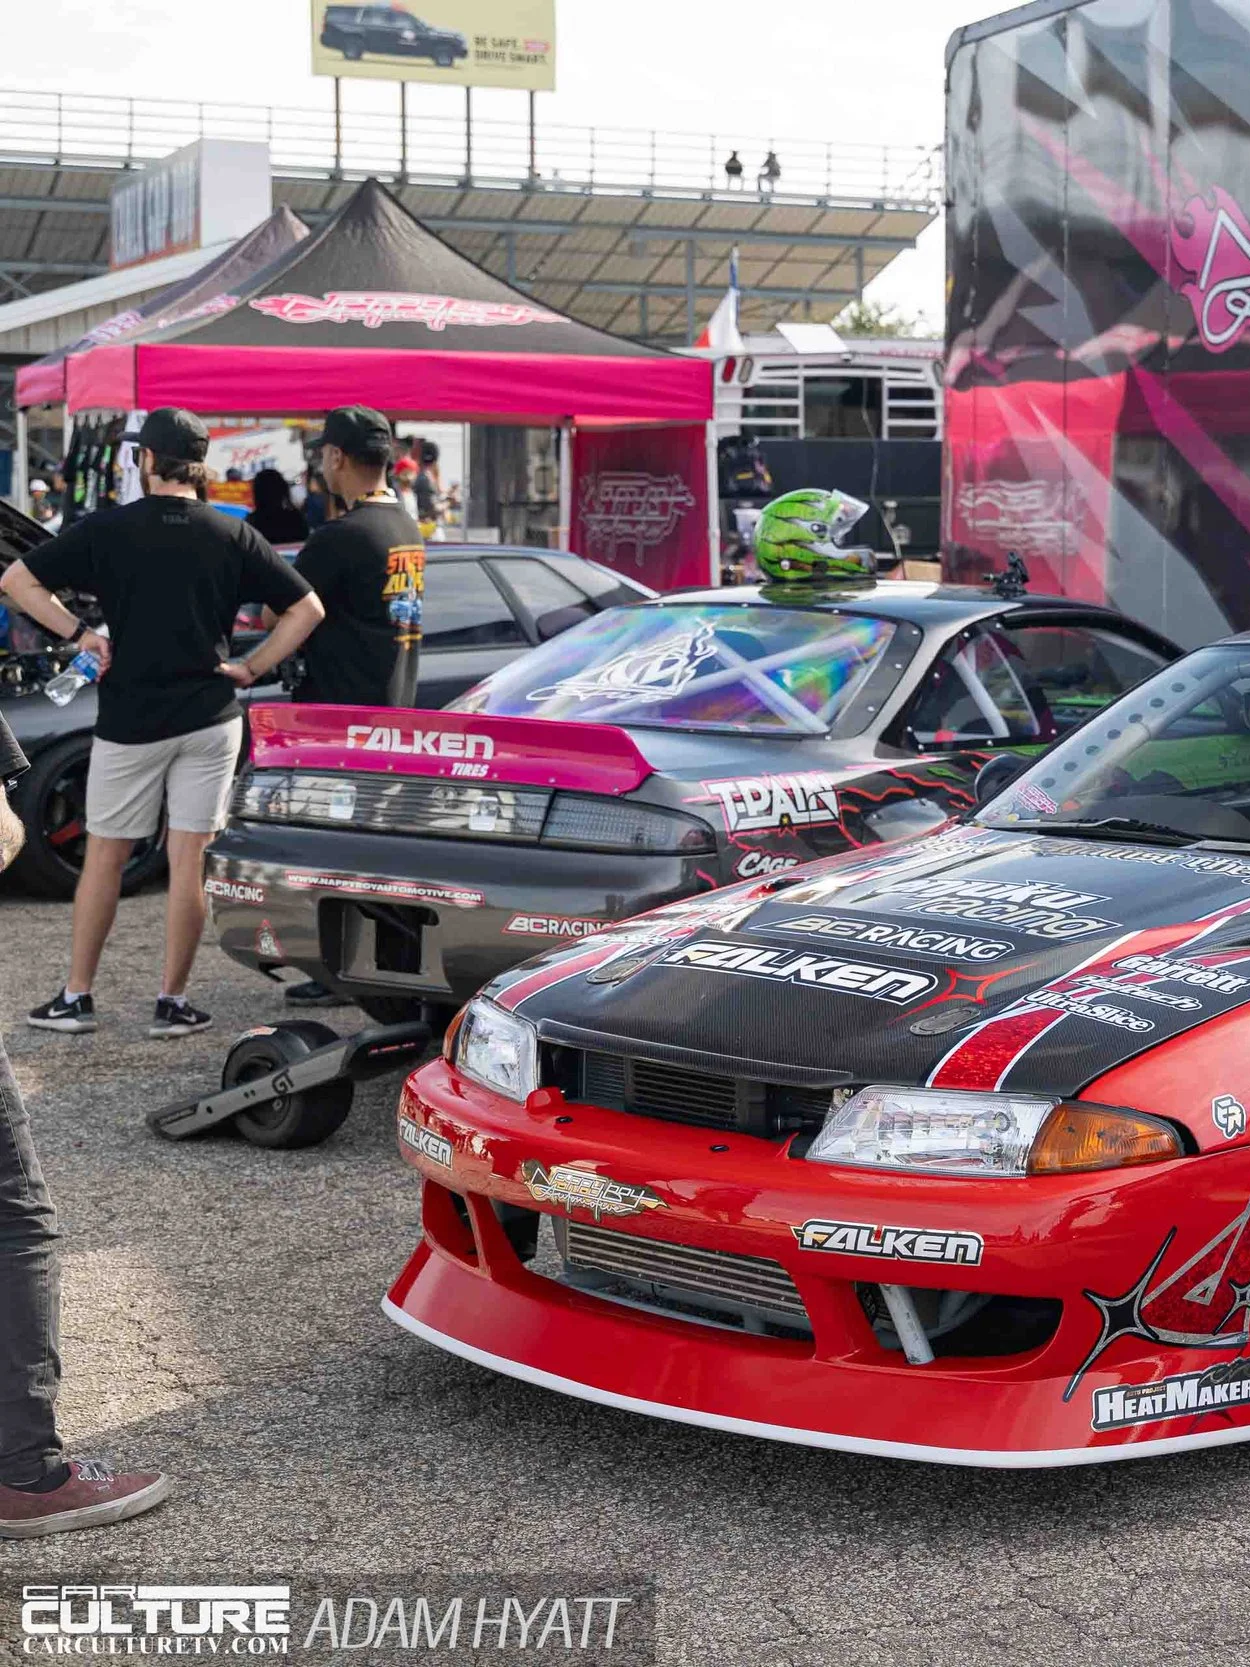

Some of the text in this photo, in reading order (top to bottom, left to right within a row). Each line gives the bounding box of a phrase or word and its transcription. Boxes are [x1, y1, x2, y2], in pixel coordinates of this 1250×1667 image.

[346, 725, 494, 760] FALKEN
[451, 762, 489, 777] TIRES
[287, 873, 482, 901] WWW.NAPPYBOYAUTOMOTIVE.COM
[900, 898, 1108, 938] racing
[668, 943, 930, 999] FALKEN
[1116, 956, 1248, 993] Garrett
[1071, 976, 1201, 1009] Haltech
[271, 1069, 295, 1096] GT
[400, 1117, 451, 1166] FALKEN
[802, 1224, 979, 1261] FALKEN
